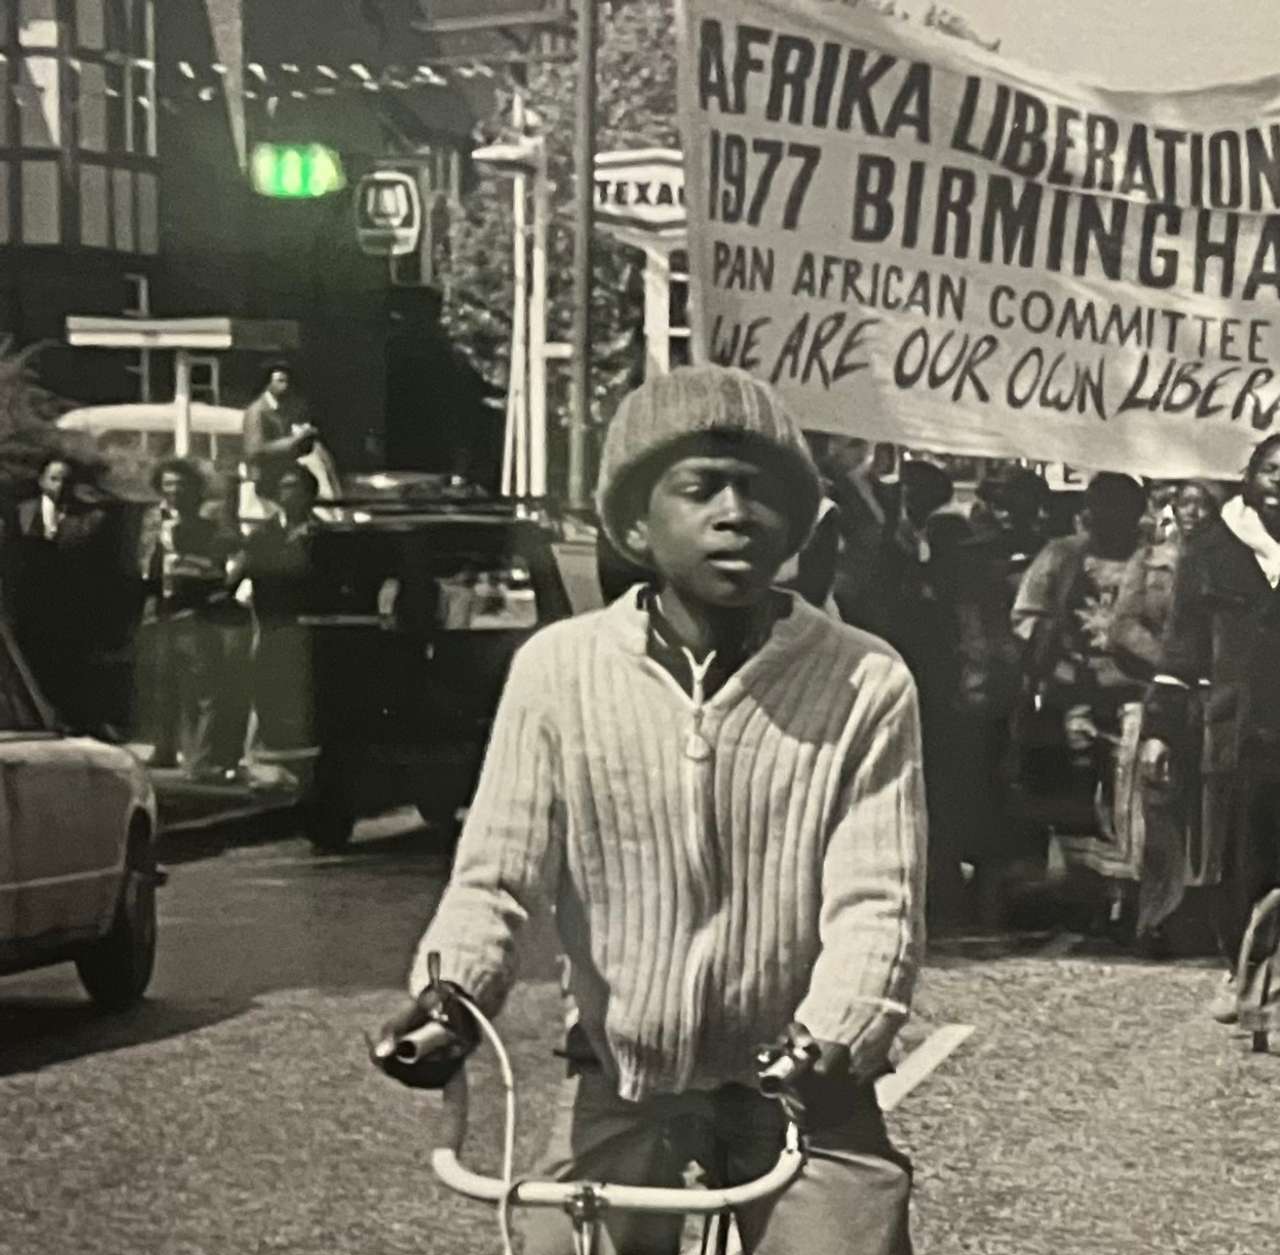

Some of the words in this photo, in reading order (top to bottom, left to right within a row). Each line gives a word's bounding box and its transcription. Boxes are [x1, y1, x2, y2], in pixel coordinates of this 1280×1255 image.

[698, 18, 932, 144] AFRIKA
[593, 179, 685, 206] TEXA
[707, 128, 823, 231] 1977
[712, 240, 775, 292] PAN
[791, 252, 967, 322] AFRICAN
[989, 284, 1273, 364] COMMITTEE
[708, 314, 772, 370] WE
[769, 311, 880, 391] ARE
[893, 326, 999, 402] OUR
[1006, 346, 1107, 421] OWN
